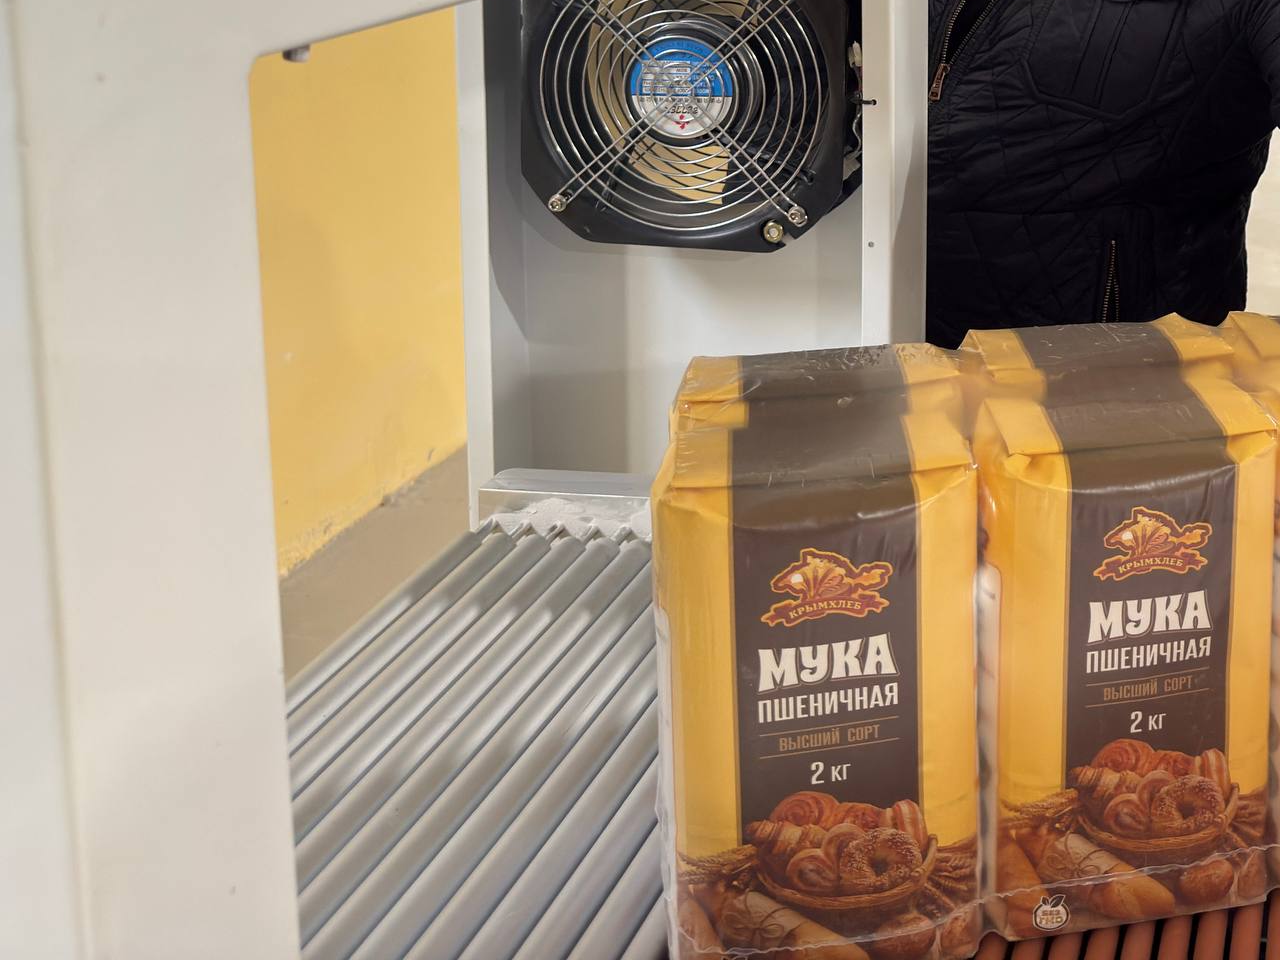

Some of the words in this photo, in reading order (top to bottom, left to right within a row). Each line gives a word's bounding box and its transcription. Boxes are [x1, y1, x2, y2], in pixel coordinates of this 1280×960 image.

[1118, 557, 1184, 574] КРЫМХЛЕБ
[788, 600, 862, 619] КРЫМХЛЕБ
[1087, 590, 1212, 644] МУКА
[758, 633, 898, 693] МУКА
[1086, 636, 1212, 674] ПШЕНИЧНАЯ
[1103, 677, 1158, 701] ВЫСШИЙ
[1164, 675, 1192, 691] СОРТ
[758, 682, 899, 723] ПШЕНИЧНАЯ
[1130, 711, 1143, 733] 2
[779, 728, 840, 752] ВЫСШИЙ
[847, 724, 880, 742] СОРТ
[810, 761, 825, 785] 2
